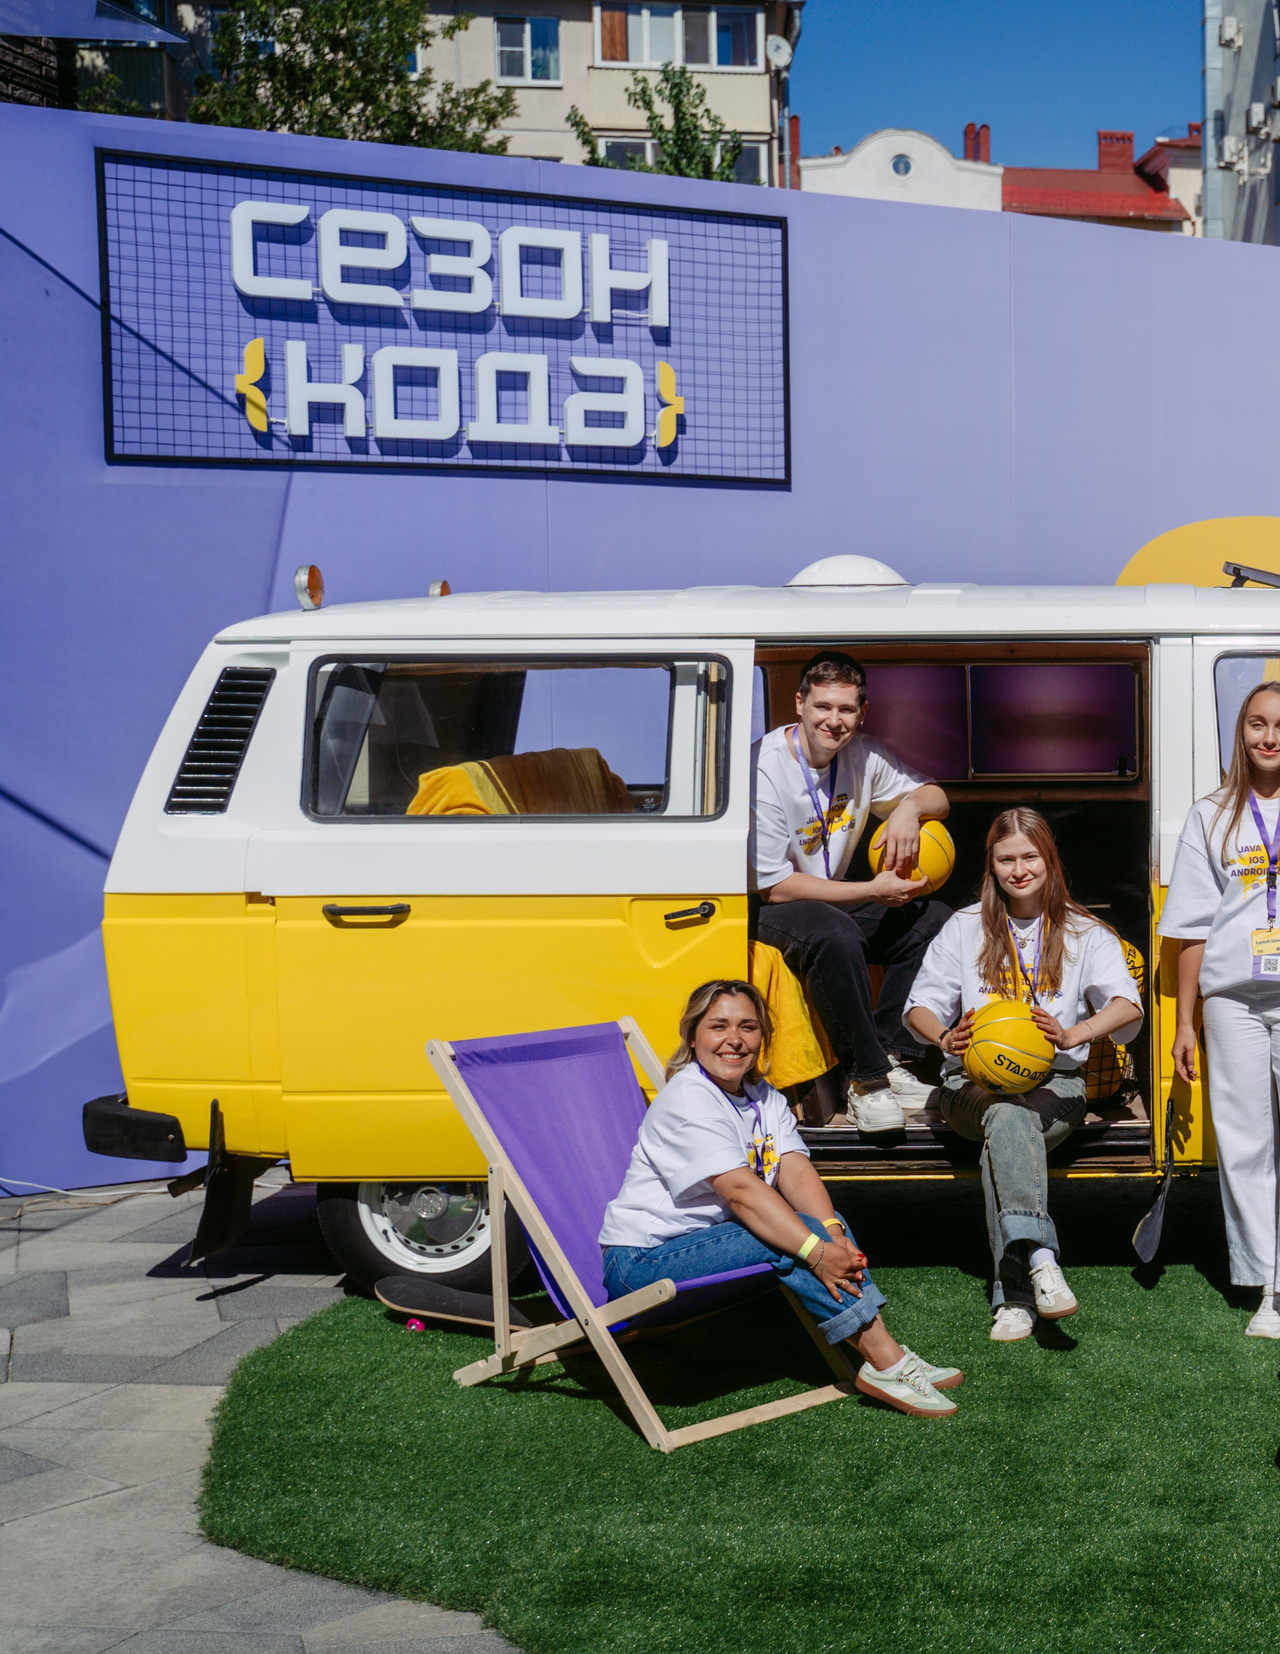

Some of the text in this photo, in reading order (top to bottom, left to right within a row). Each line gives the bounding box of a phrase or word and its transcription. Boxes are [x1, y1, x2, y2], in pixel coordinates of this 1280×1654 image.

[1239, 845, 1262, 853] JAVA
[1249, 856, 1265, 864] IOS
[1230, 867, 1268, 877] ANDROI
